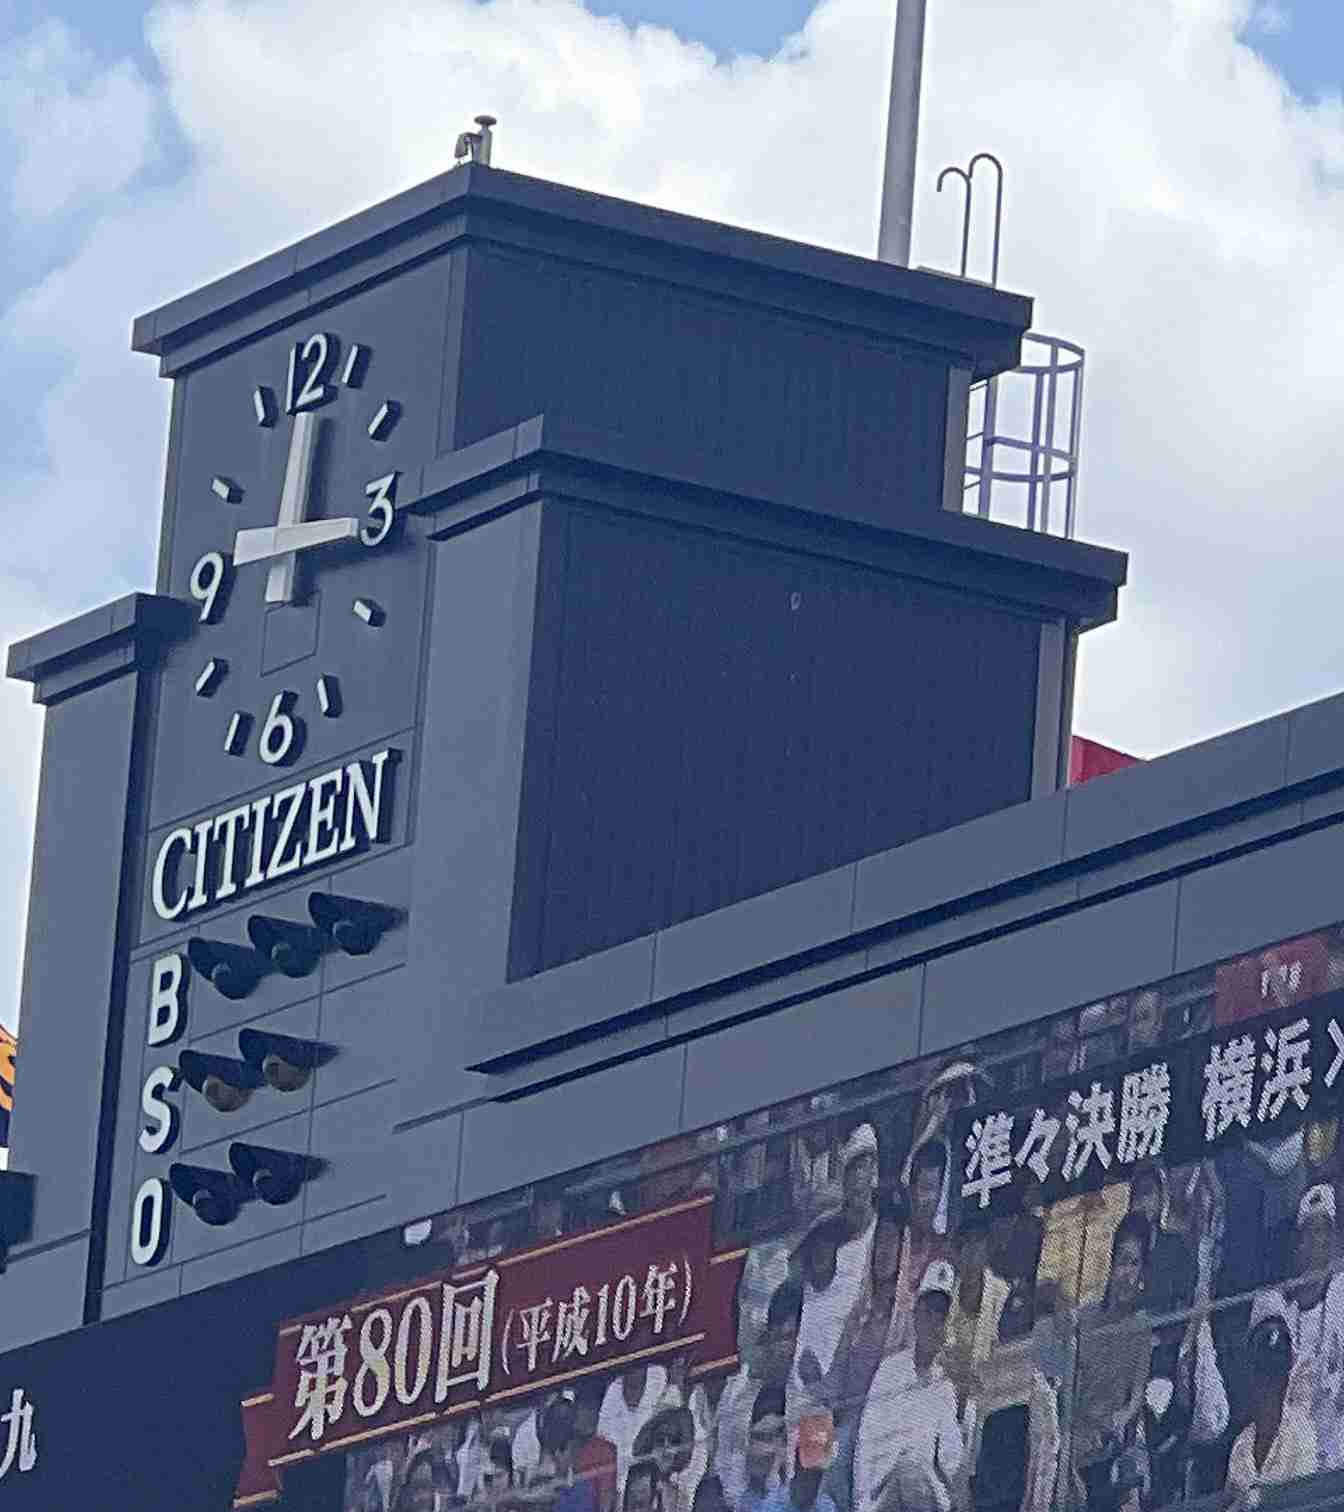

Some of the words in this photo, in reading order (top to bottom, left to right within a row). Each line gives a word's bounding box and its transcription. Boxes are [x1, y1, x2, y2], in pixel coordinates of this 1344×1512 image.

[285, 333, 332, 414] 12
[360, 471, 400, 546] 3
[189, 552, 225, 623] 9
[259, 691, 296, 765] 6
[152, 749, 391, 920] CITIZEN
[147, 952, 184, 1046] B
[138, 1065, 175, 1154] S
[959, 1061, 1171, 1208] 準々決勝
[287, 1268, 500, 1442] 第80回
